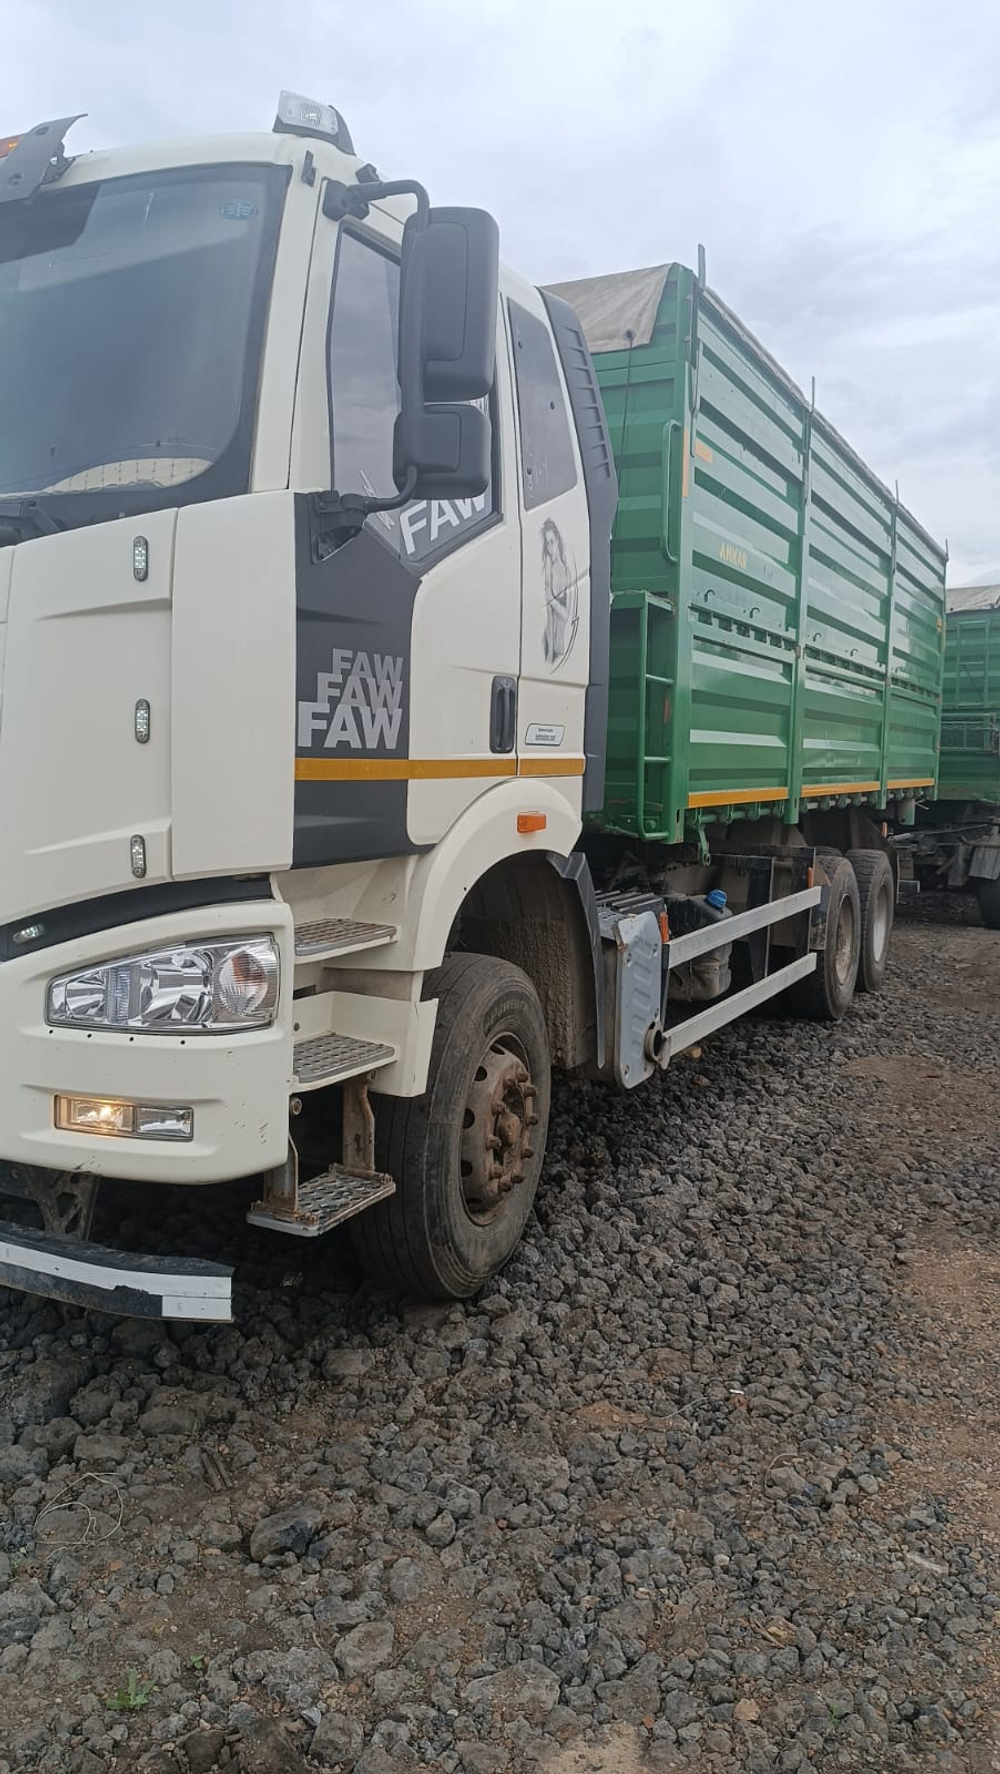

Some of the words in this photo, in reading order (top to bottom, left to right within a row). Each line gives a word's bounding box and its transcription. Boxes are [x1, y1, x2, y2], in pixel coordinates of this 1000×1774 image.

[400, 494, 486, 555] FAW
[332, 648, 404, 687] FAW
[317, 672, 403, 716] FAW
[297, 701, 403, 749] FAW
